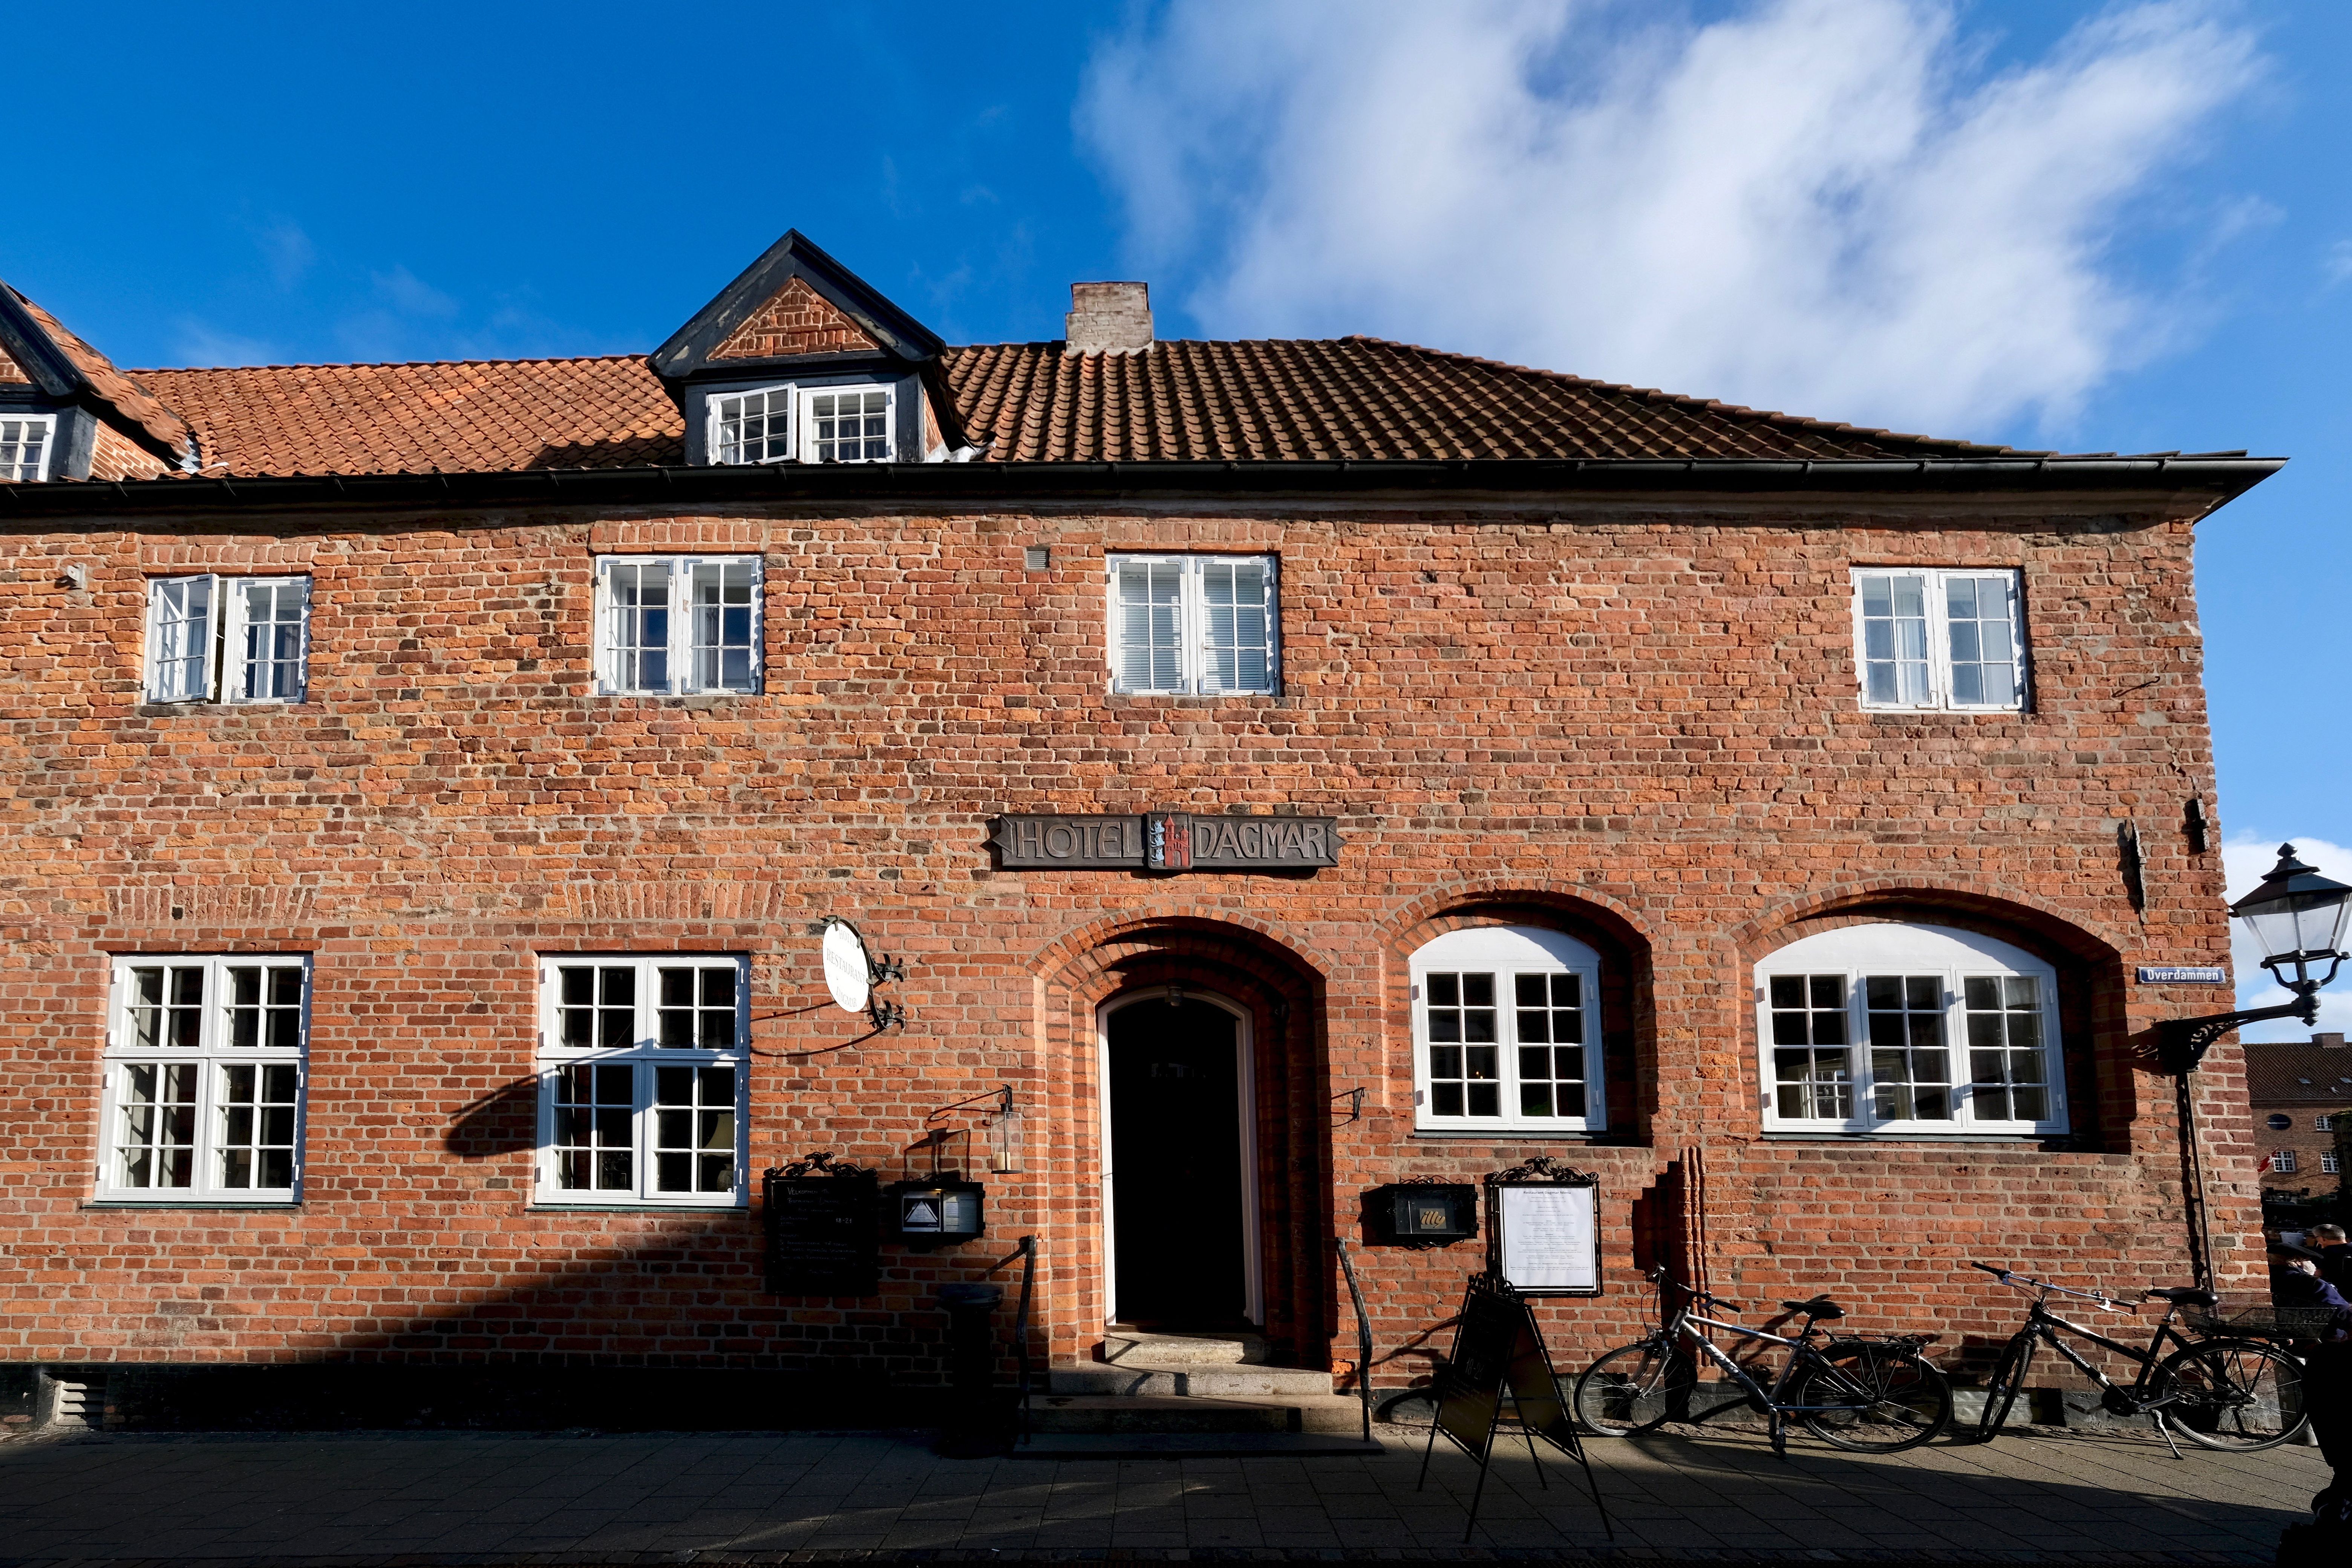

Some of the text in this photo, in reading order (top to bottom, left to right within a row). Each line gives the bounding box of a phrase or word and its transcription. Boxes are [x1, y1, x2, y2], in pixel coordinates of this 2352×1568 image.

[1015, 821, 1326, 858] HOTEL DAGMAR
[839, 929, 856, 950] HOTEL
[827, 947, 866, 985] RESTAURANT
[2147, 969, 2219, 980] Overdammen
[1421, 1211, 1445, 1228] illy
[1700, 1343, 1749, 1380] GIANT
